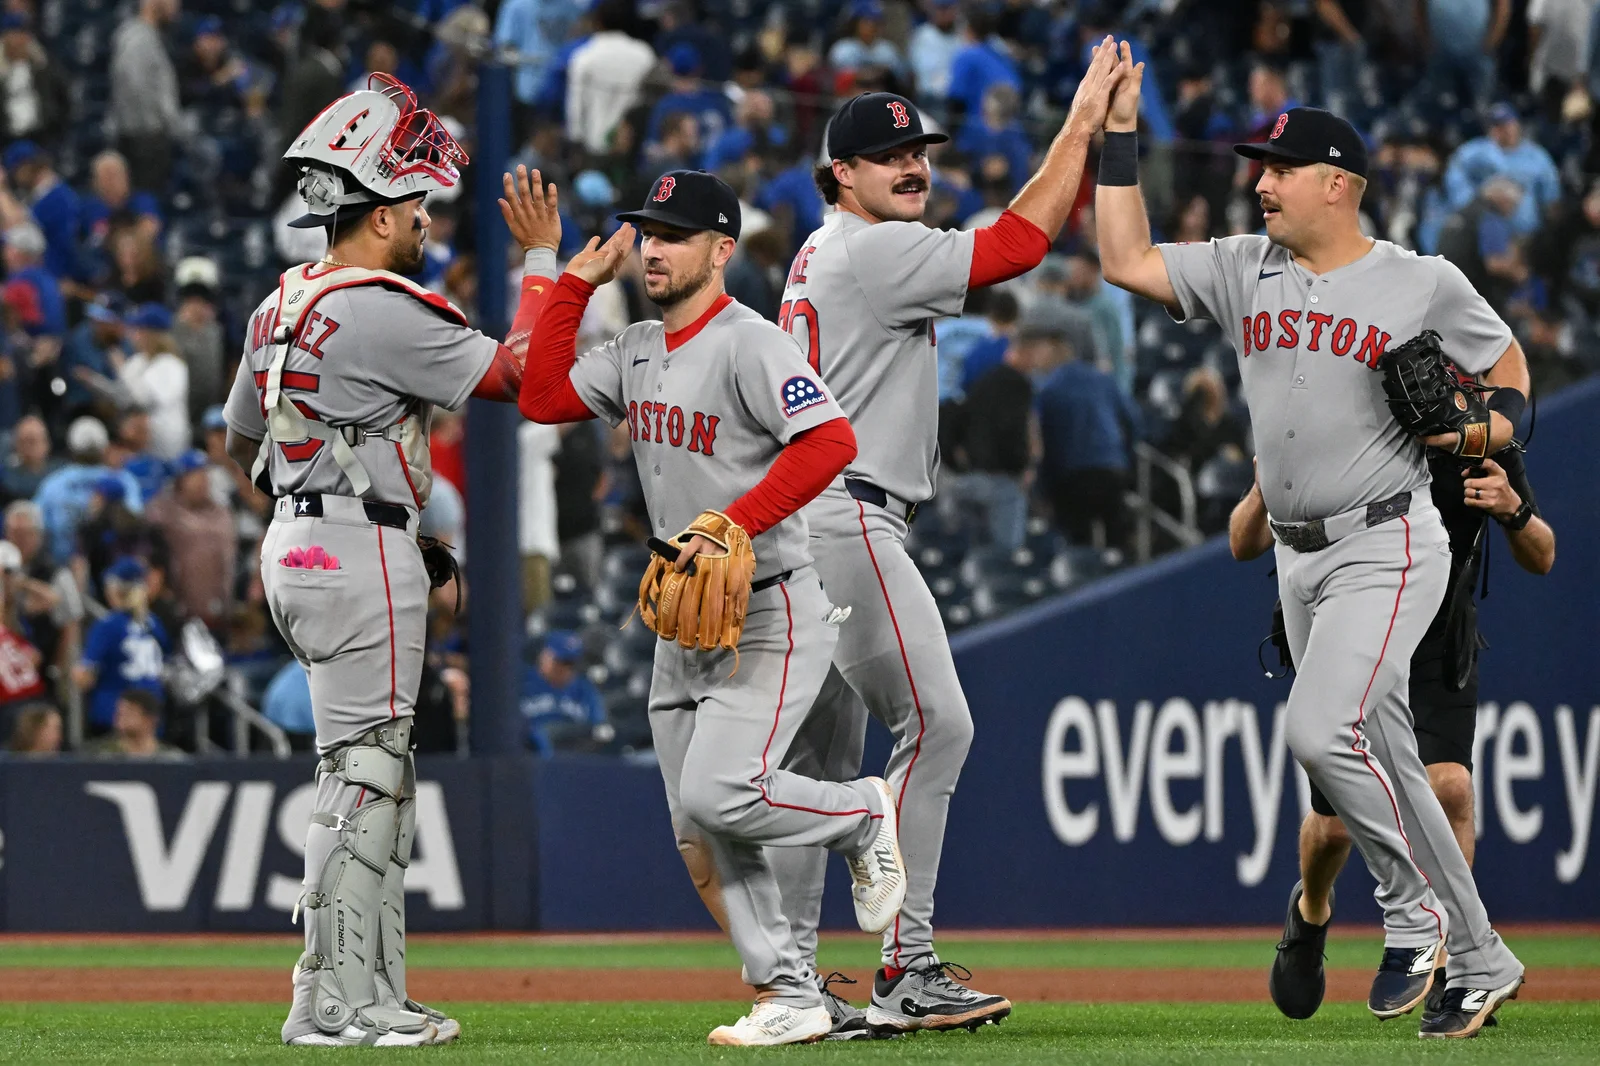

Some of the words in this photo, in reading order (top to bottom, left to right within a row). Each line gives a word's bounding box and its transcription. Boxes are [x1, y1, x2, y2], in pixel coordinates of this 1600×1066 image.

[887, 101, 910, 128] B
[1270, 113, 1288, 139] B
[653, 176, 676, 202] B
[1242, 308, 1392, 371] BOSTON
[785, 393, 826, 415] MassMutual
[625, 399, 721, 456] OSTON
[1042, 696, 1545, 886] everyre
